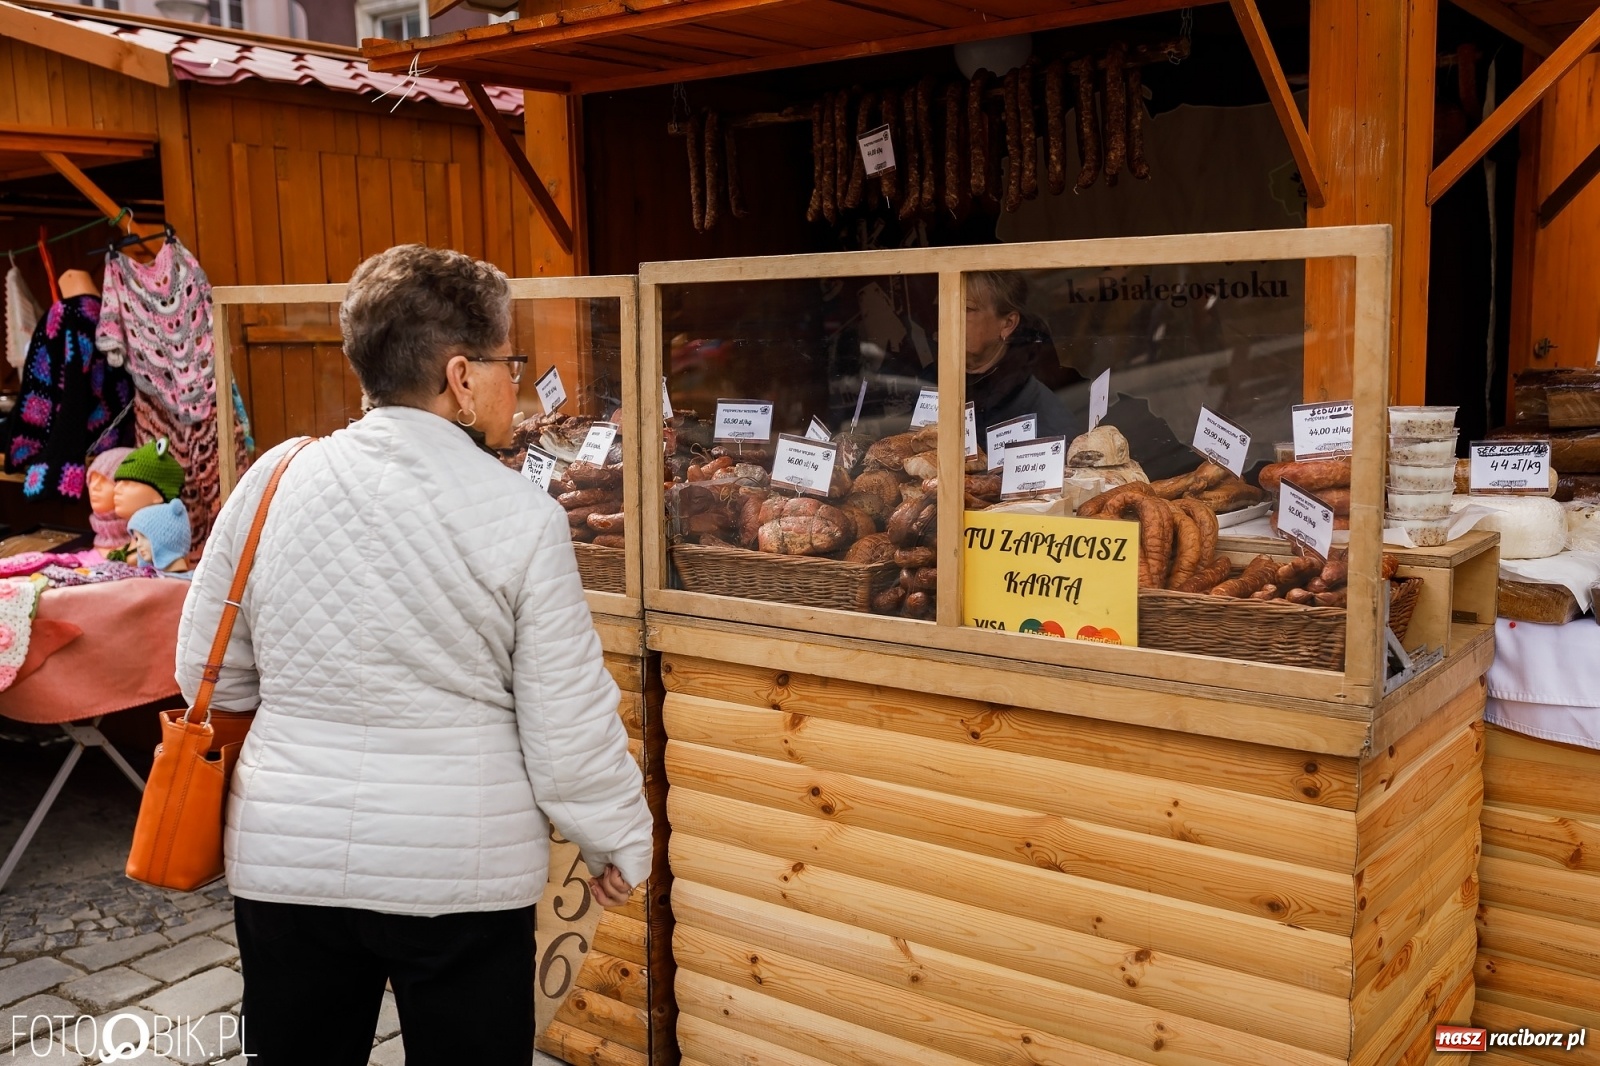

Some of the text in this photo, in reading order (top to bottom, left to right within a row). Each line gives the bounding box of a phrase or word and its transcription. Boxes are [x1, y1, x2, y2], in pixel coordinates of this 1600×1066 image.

[1309, 425, 1352, 437] 44,00 zł/kg
[964, 527, 1128, 563] TU ZAPŁACISZ
[1003, 571, 1083, 605] KARTĄ
[972, 617, 1006, 631] VISA
[553, 850, 591, 922] 5
[540, 931, 588, 999] 6
